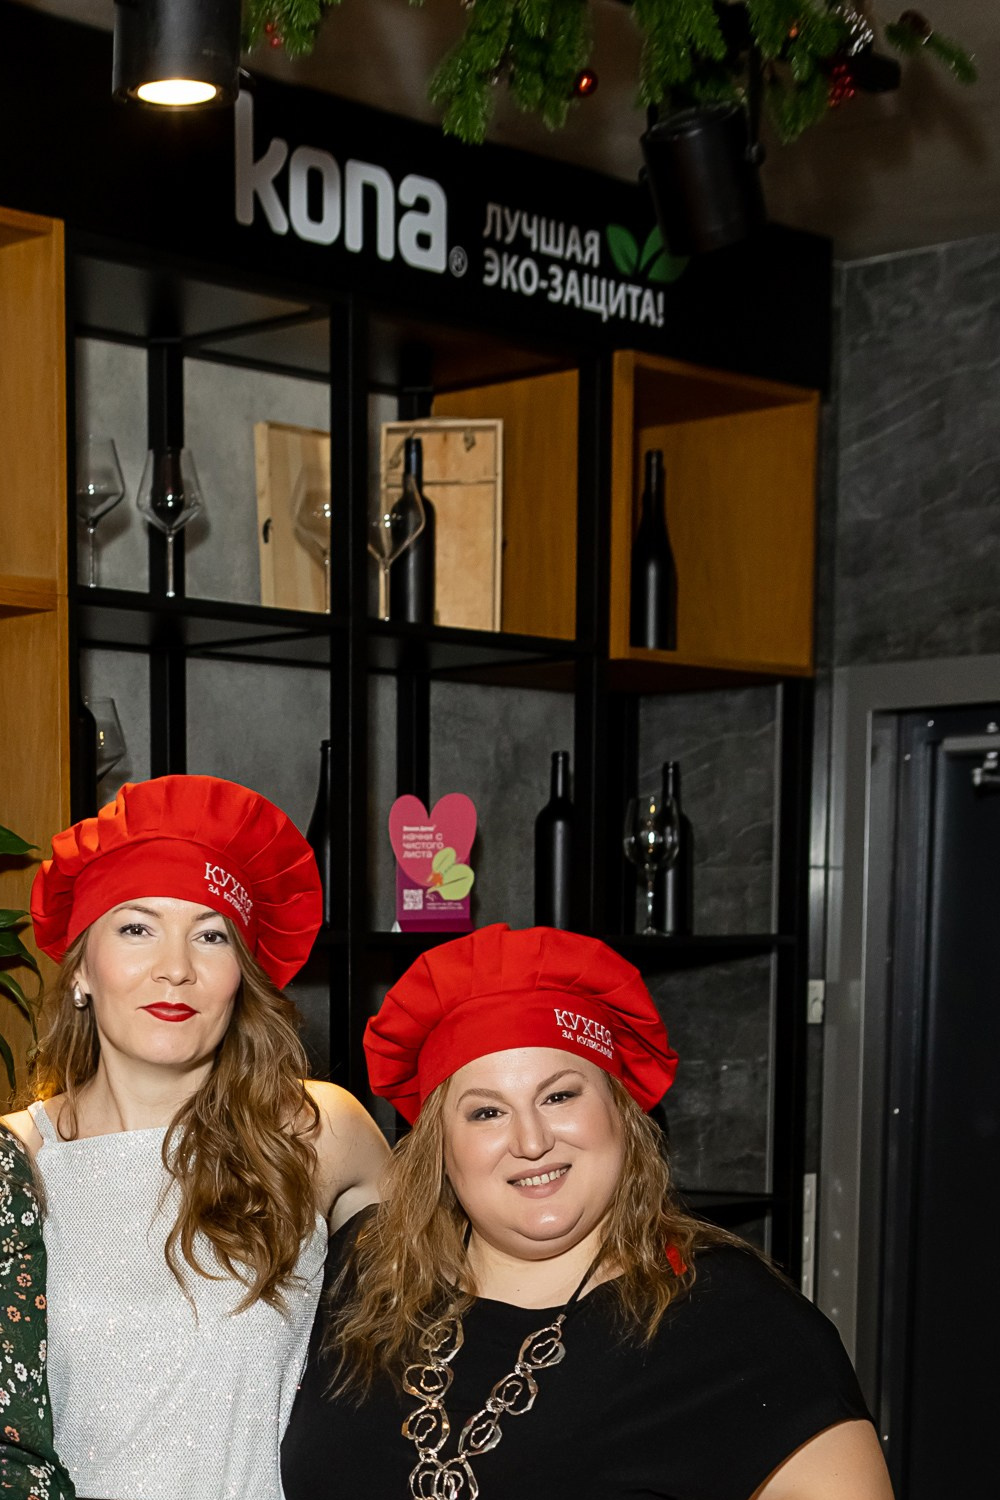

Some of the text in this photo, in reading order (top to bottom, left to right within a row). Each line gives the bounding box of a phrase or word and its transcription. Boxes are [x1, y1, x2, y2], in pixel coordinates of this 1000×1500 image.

[234, 89, 449, 274] kona
[482, 201, 601, 267] ЛУЧШАЯ
[482, 247, 665, 328] ЭКО-ЗАЩИТА!
[554, 1008, 614, 1050] КУХНЯ
[562, 1029, 574, 1040] ЗА
